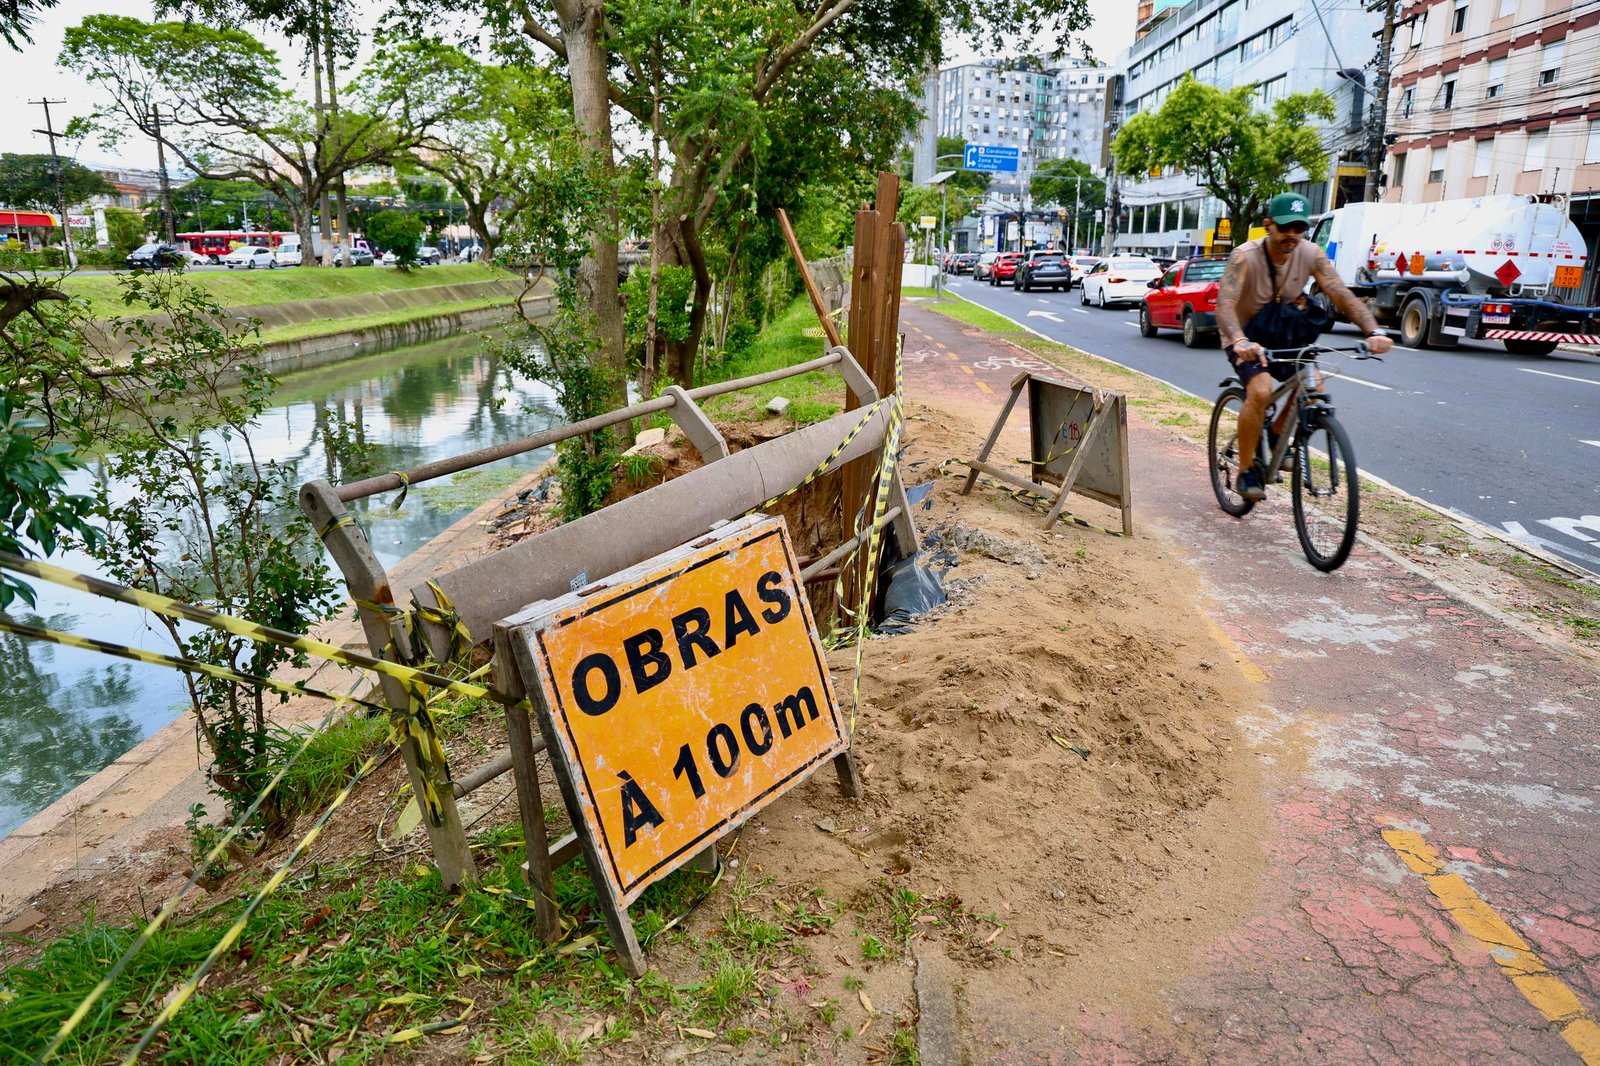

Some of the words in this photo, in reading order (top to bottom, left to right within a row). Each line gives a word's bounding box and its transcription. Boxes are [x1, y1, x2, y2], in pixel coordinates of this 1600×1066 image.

[985, 147, 1017, 156] Cardiologia
[1558, 277, 1578, 286] 1202
[571, 569, 793, 717] OBRAS
[616, 768, 665, 849] À
[673, 685, 820, 799] 100m
